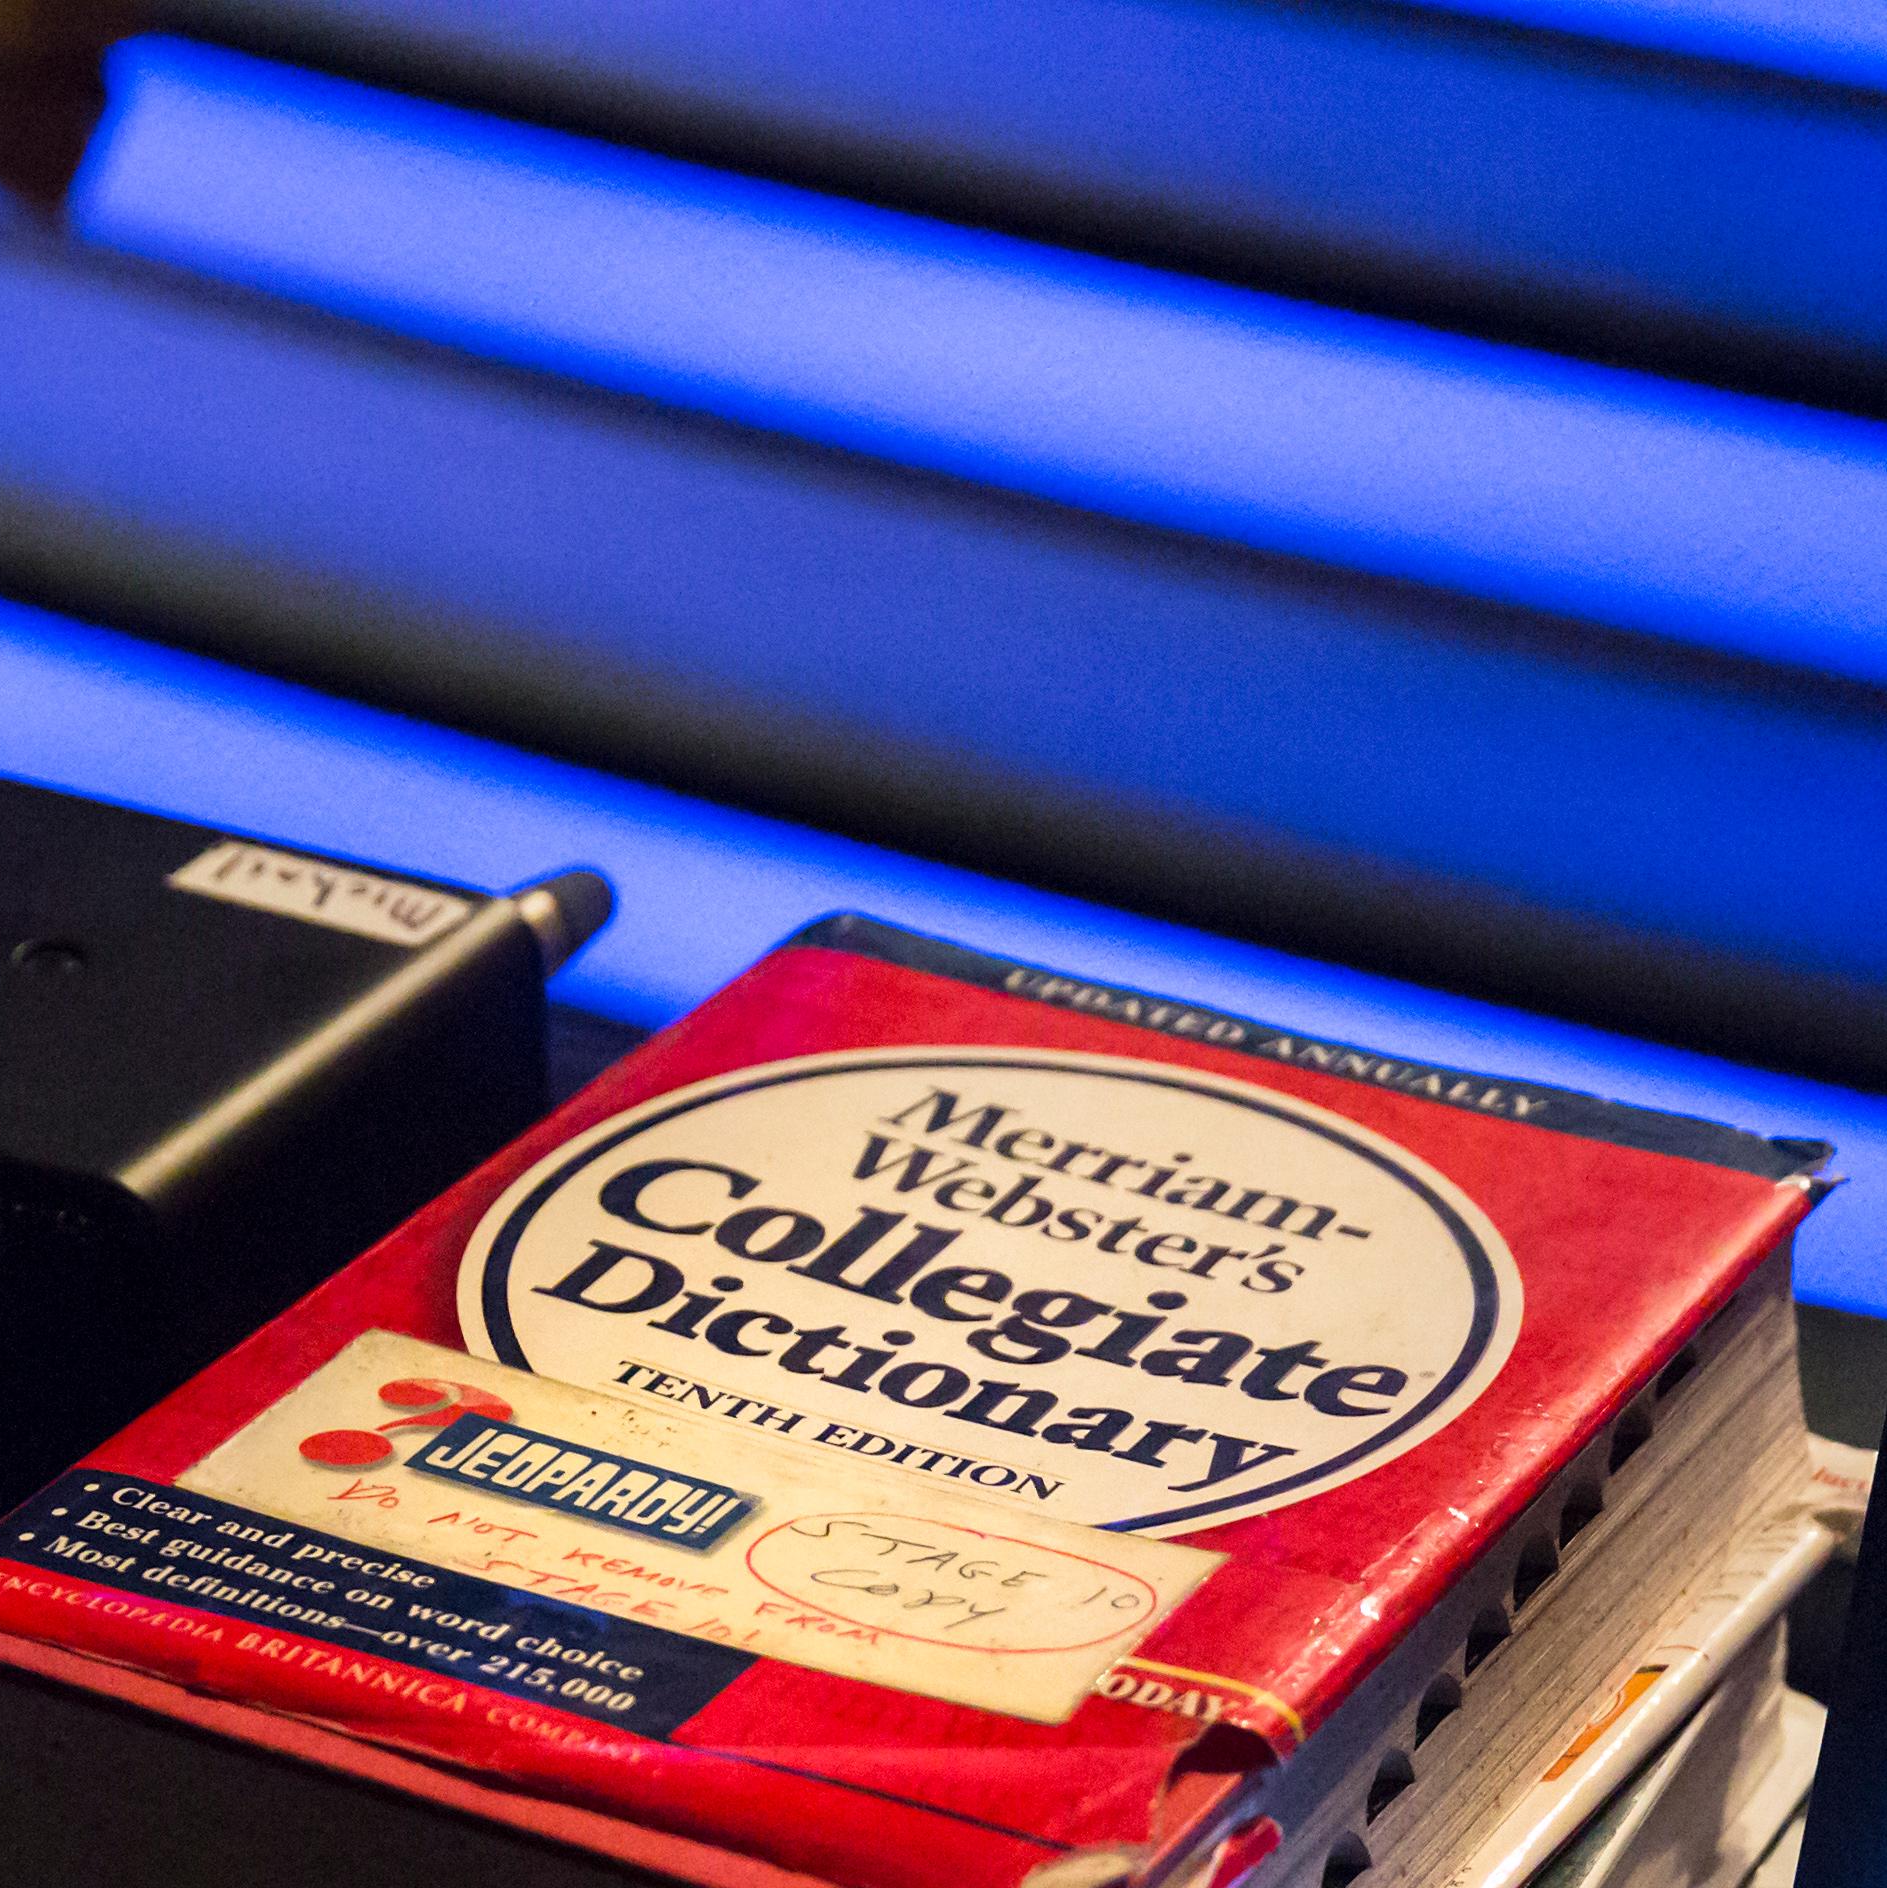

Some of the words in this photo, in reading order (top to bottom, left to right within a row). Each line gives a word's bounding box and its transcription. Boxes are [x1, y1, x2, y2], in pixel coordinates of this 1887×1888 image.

[1004, 968, 1247, 1045] UPDATED
[1259, 1035, 1549, 1118] ANNUALLY
[852, 1131, 1308, 1295] Webster's
[878, 1086, 1373, 1243] Merriam-
[599, 1158, 1407, 1419] Collegiate
[530, 1238, 1299, 1493] Dictionary
[616, 1359, 804, 1436] TENTH
[814, 1422, 1067, 1502] EDITION
[112, 1486, 212, 1526] Clear
[215, 1520, 295, 1549] and
[290, 1542, 437, 1590] precise
[424, 1428, 743, 1537] JEOPARDY!
[790, 1520, 1049, 1588] STAGE
[42, 1534, 137, 1573] Most
[478, 1653, 638, 1712] 215,000
[75, 1509, 161, 1545] Best
[159, 1536, 337, 1595] guidance
[344, 1588, 395, 1611] on
[408, 1603, 513, 1643] word
[514, 1635, 646, 1682] choice
[427, 1510, 538, 1543] NOT
[562, 1546, 729, 1598] REMOVE
[753, 1600, 880, 1646] FROM
[450, 1556, 678, 1621] STAGE
[234, 1631, 469, 1714] BRITANNICA
